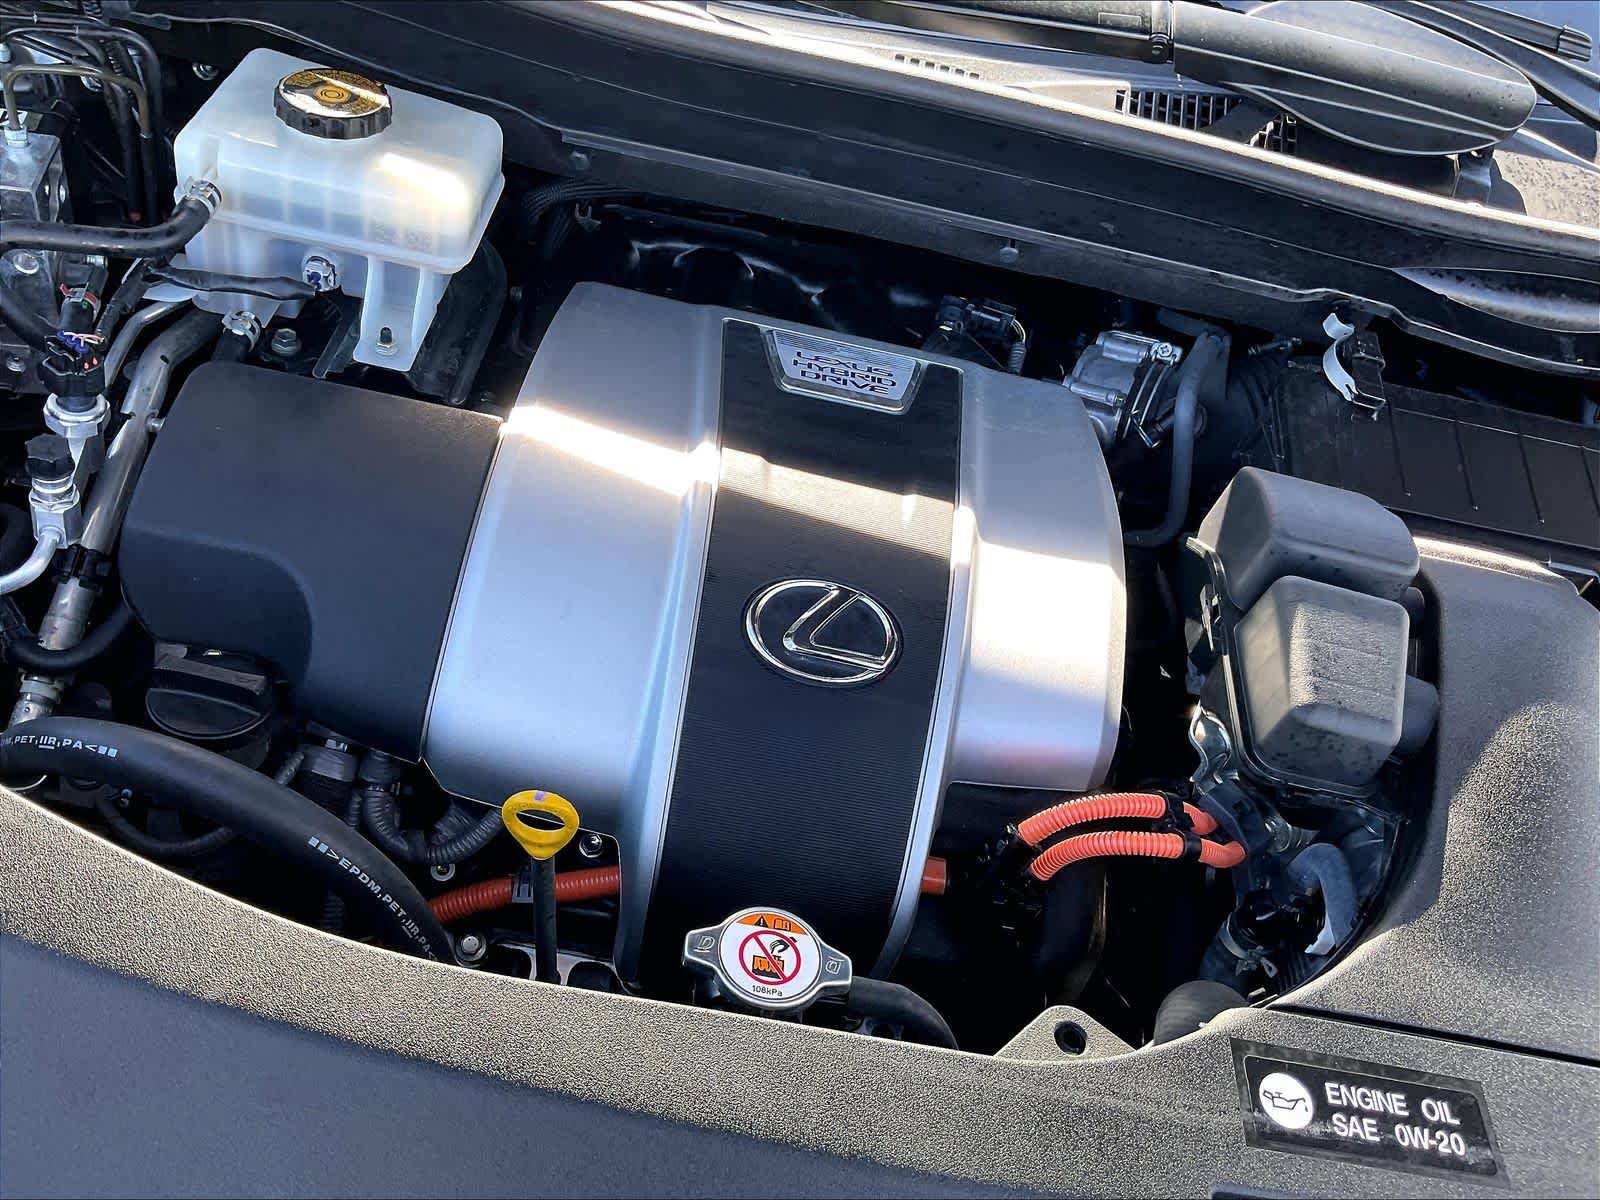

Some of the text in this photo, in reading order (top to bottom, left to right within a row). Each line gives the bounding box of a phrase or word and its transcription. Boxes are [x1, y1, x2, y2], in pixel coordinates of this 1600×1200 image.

[792, 359, 897, 387] HYBRID
[796, 351, 894, 378] LEXUS
[801, 370, 889, 395] DRIVE
[751, 984, 784, 997] 108kPa
[1324, 1081, 1461, 1126] ENGINE OIL
[1331, 1113, 1467, 1157] SAE 0W-20
